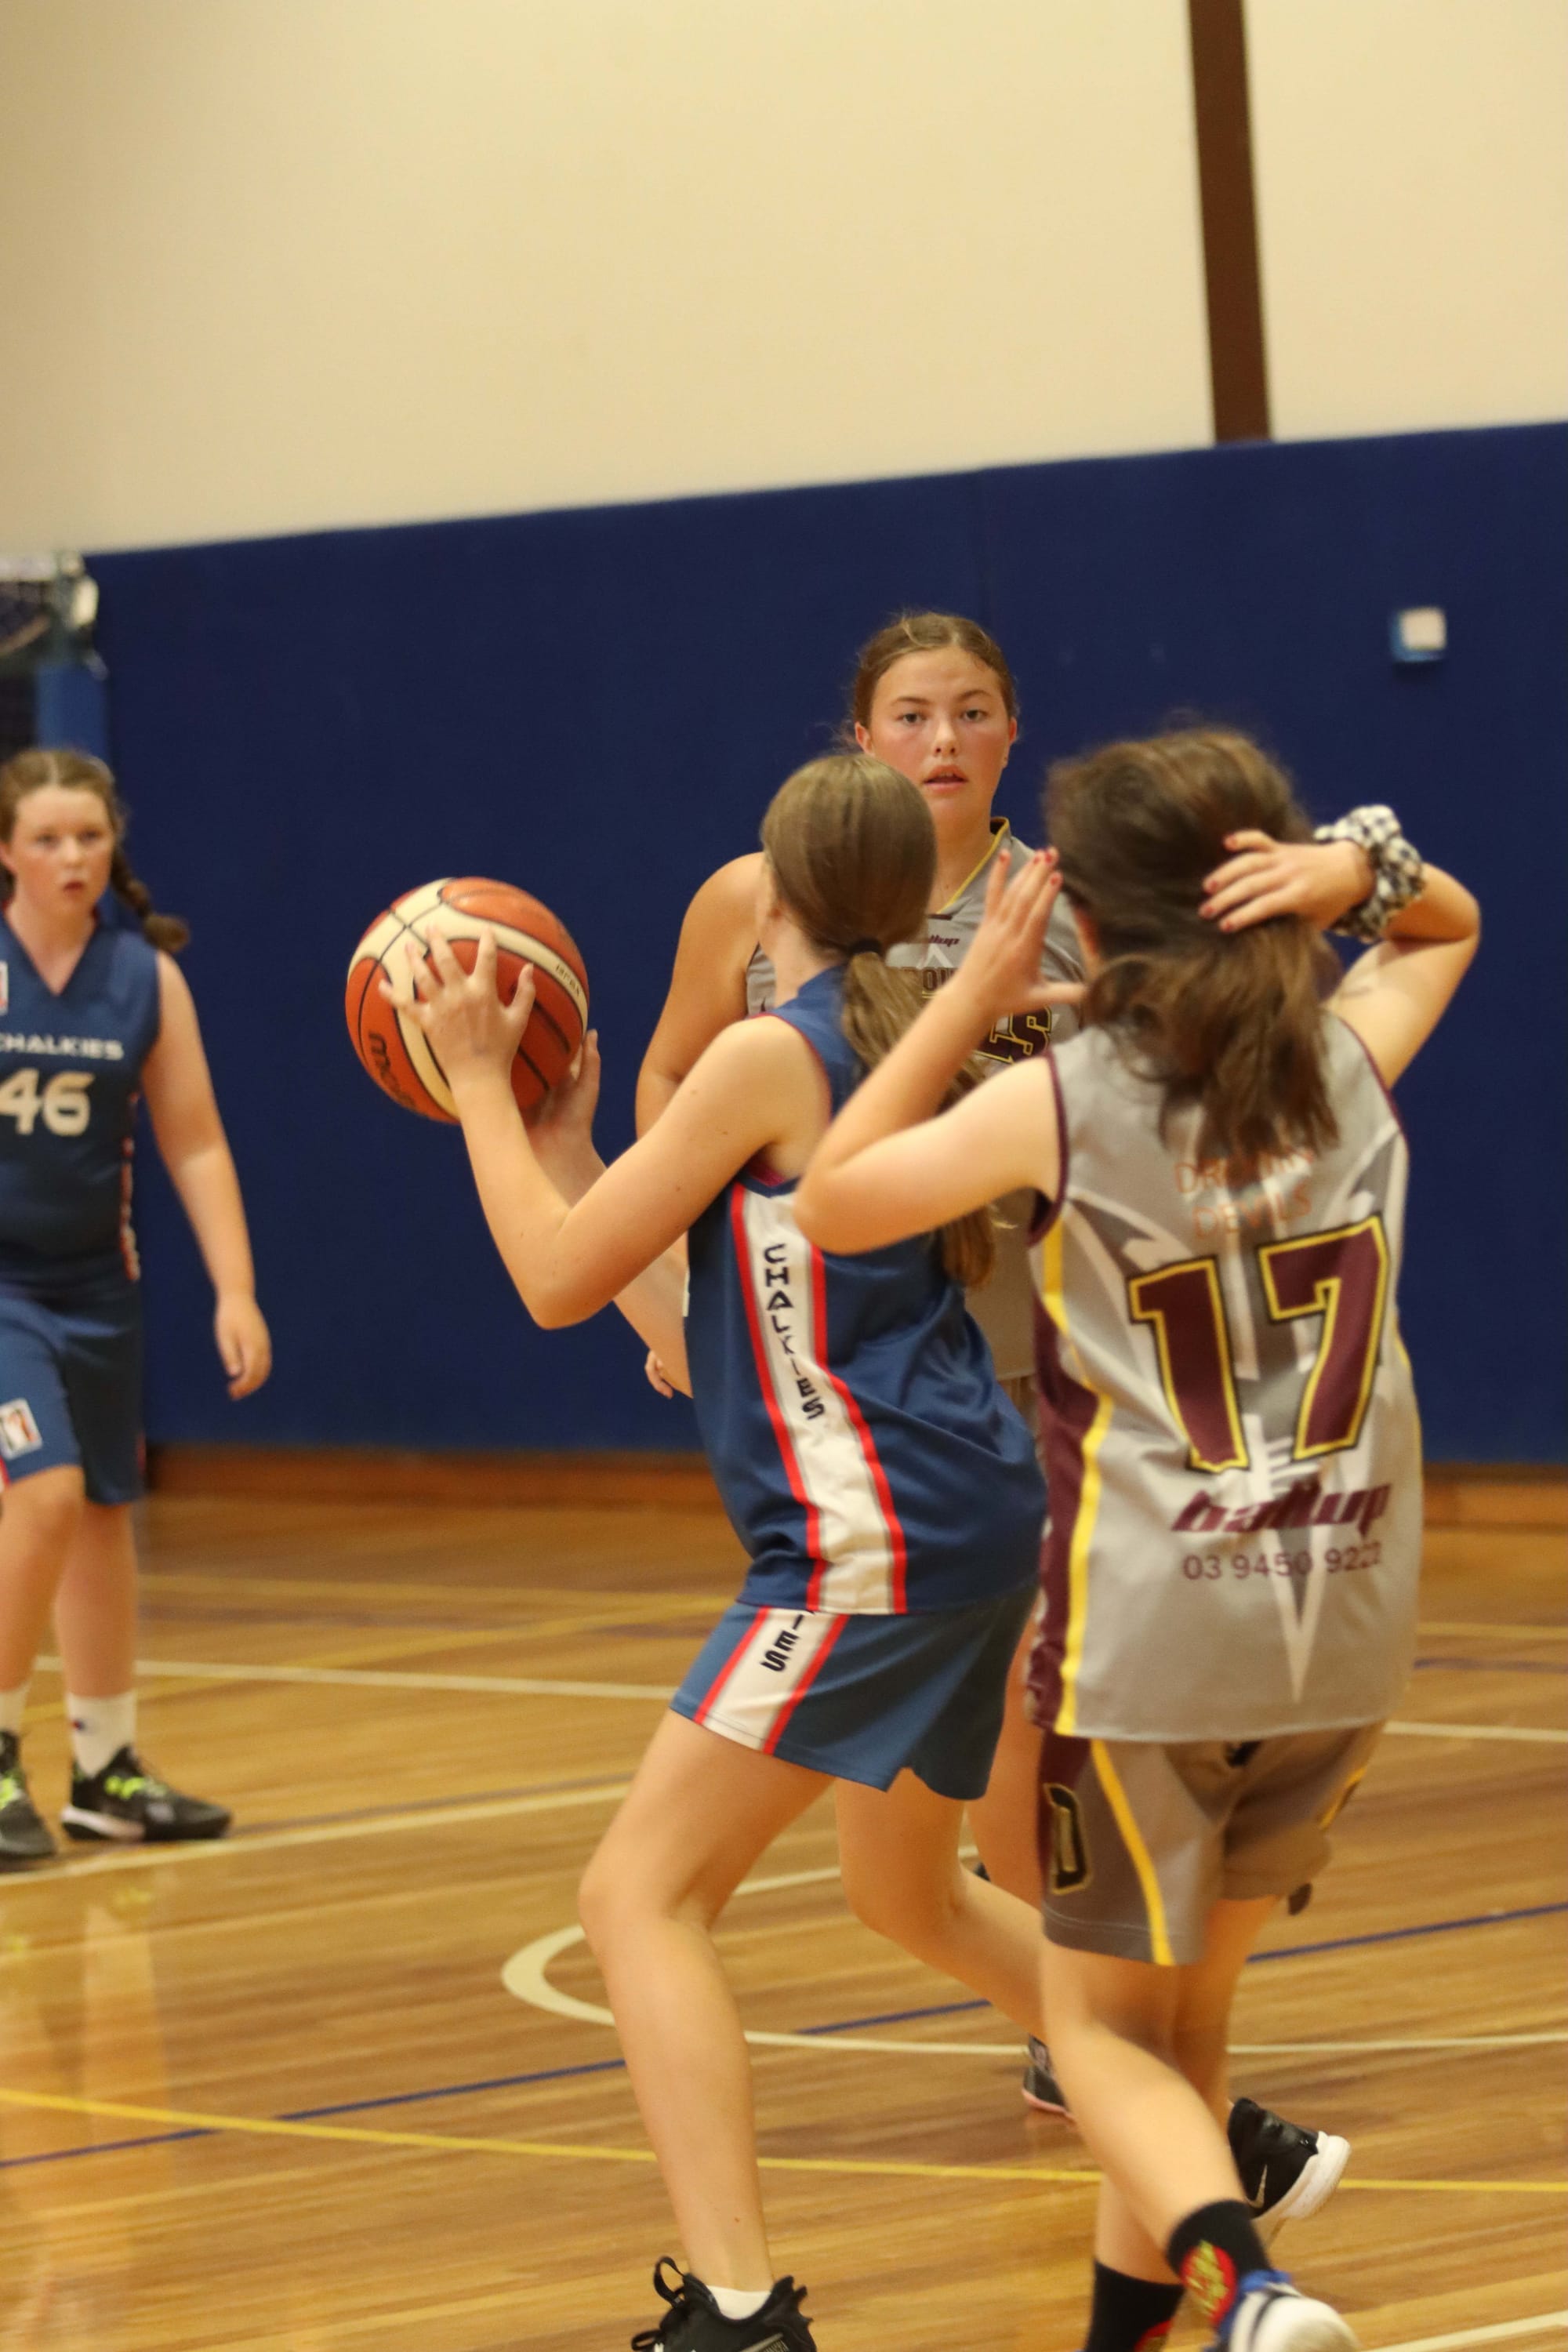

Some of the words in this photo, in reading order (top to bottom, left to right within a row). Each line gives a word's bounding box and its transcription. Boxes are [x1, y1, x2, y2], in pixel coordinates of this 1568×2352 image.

[0, 1069, 95, 1136] 46
[763, 1243, 826, 1421] CHALKIES
[1127, 1213, 1388, 1473] 17
[1182, 1553, 1221, 1581] 03
